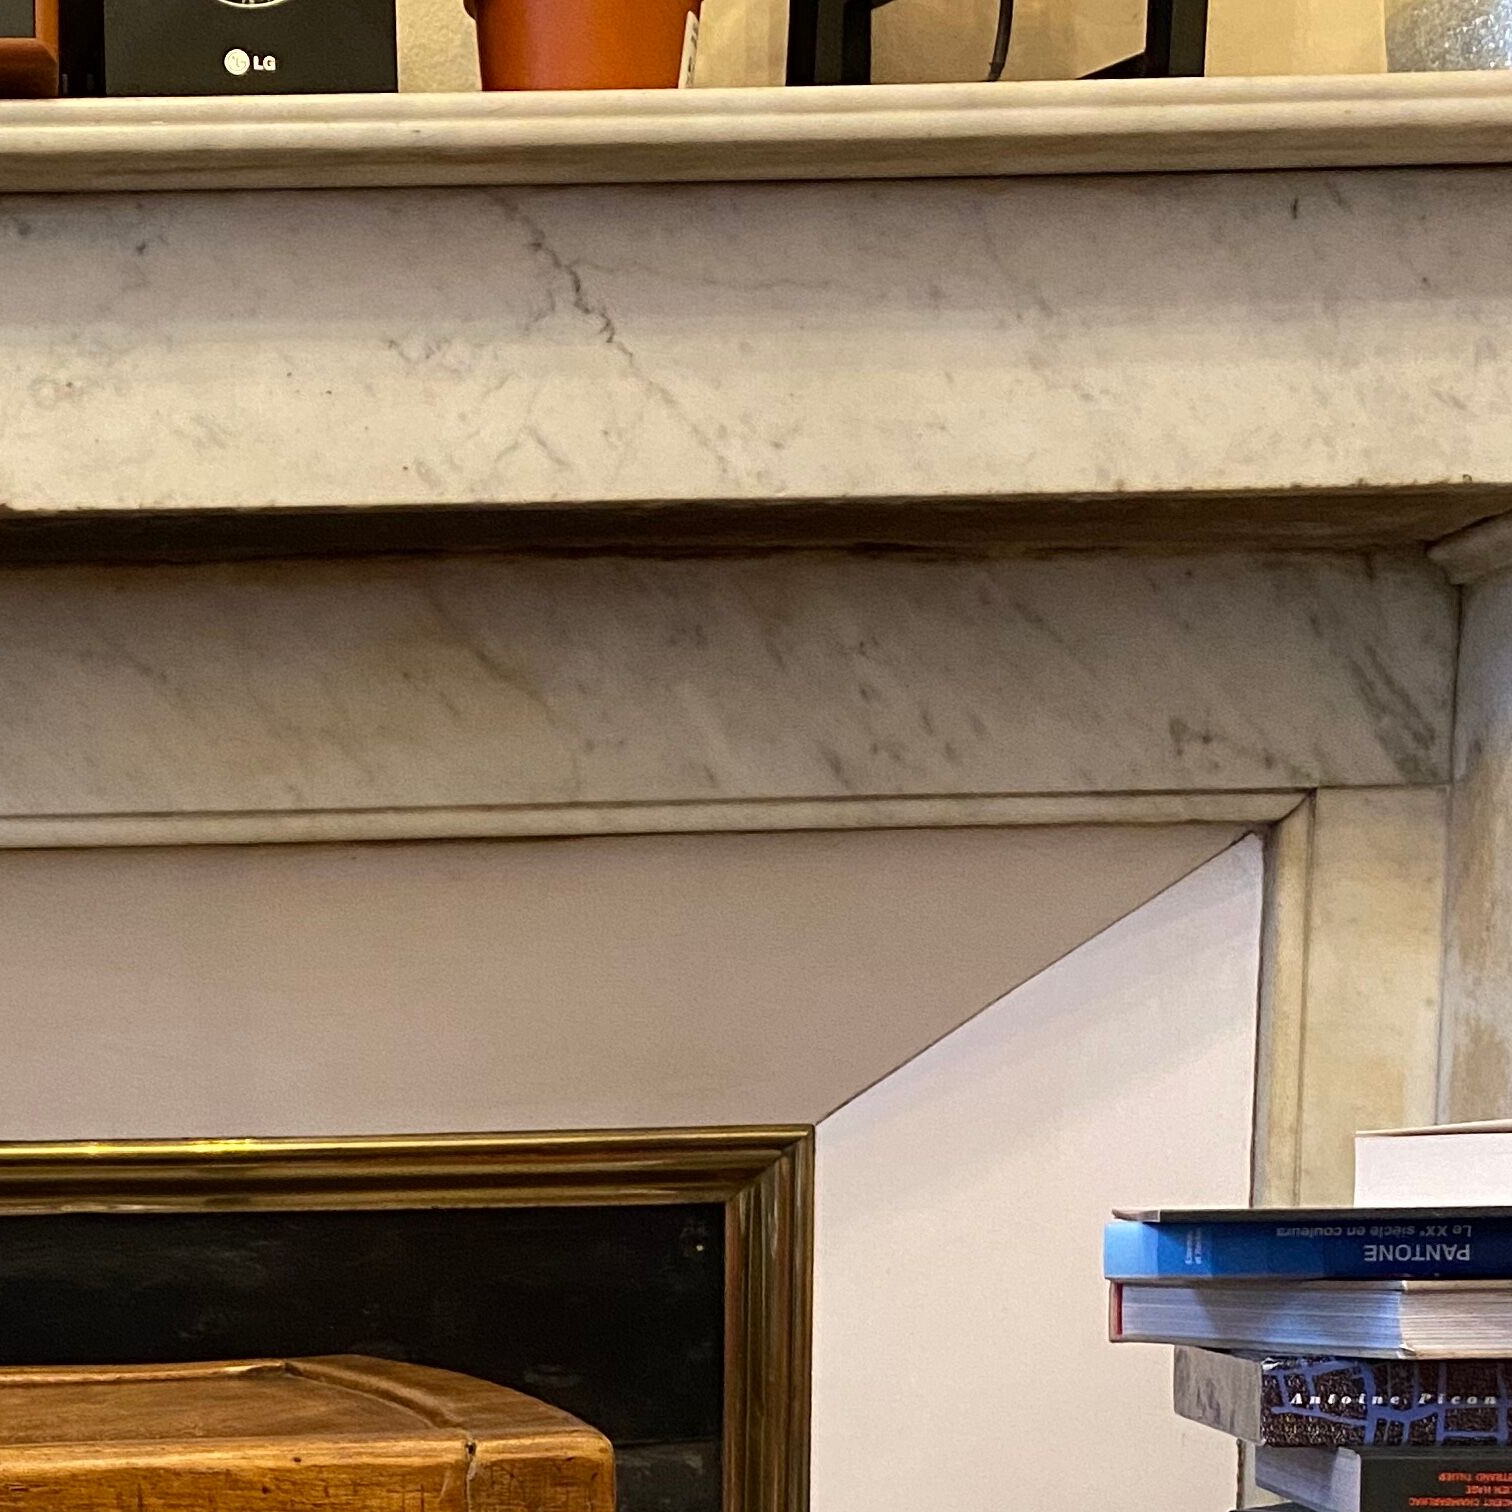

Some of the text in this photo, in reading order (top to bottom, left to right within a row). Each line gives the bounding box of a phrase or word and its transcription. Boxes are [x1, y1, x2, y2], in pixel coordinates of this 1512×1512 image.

[252, 55, 276, 71] LG
[1276, 1226, 1342, 1238] couleurs
[1346, 1226, 1366, 1237] en
[1452, 1224, 1472, 1238] Le
[1363, 1243, 1471, 1262] PANTONE
[1290, 1392, 1498, 1406] Antoine Picon
